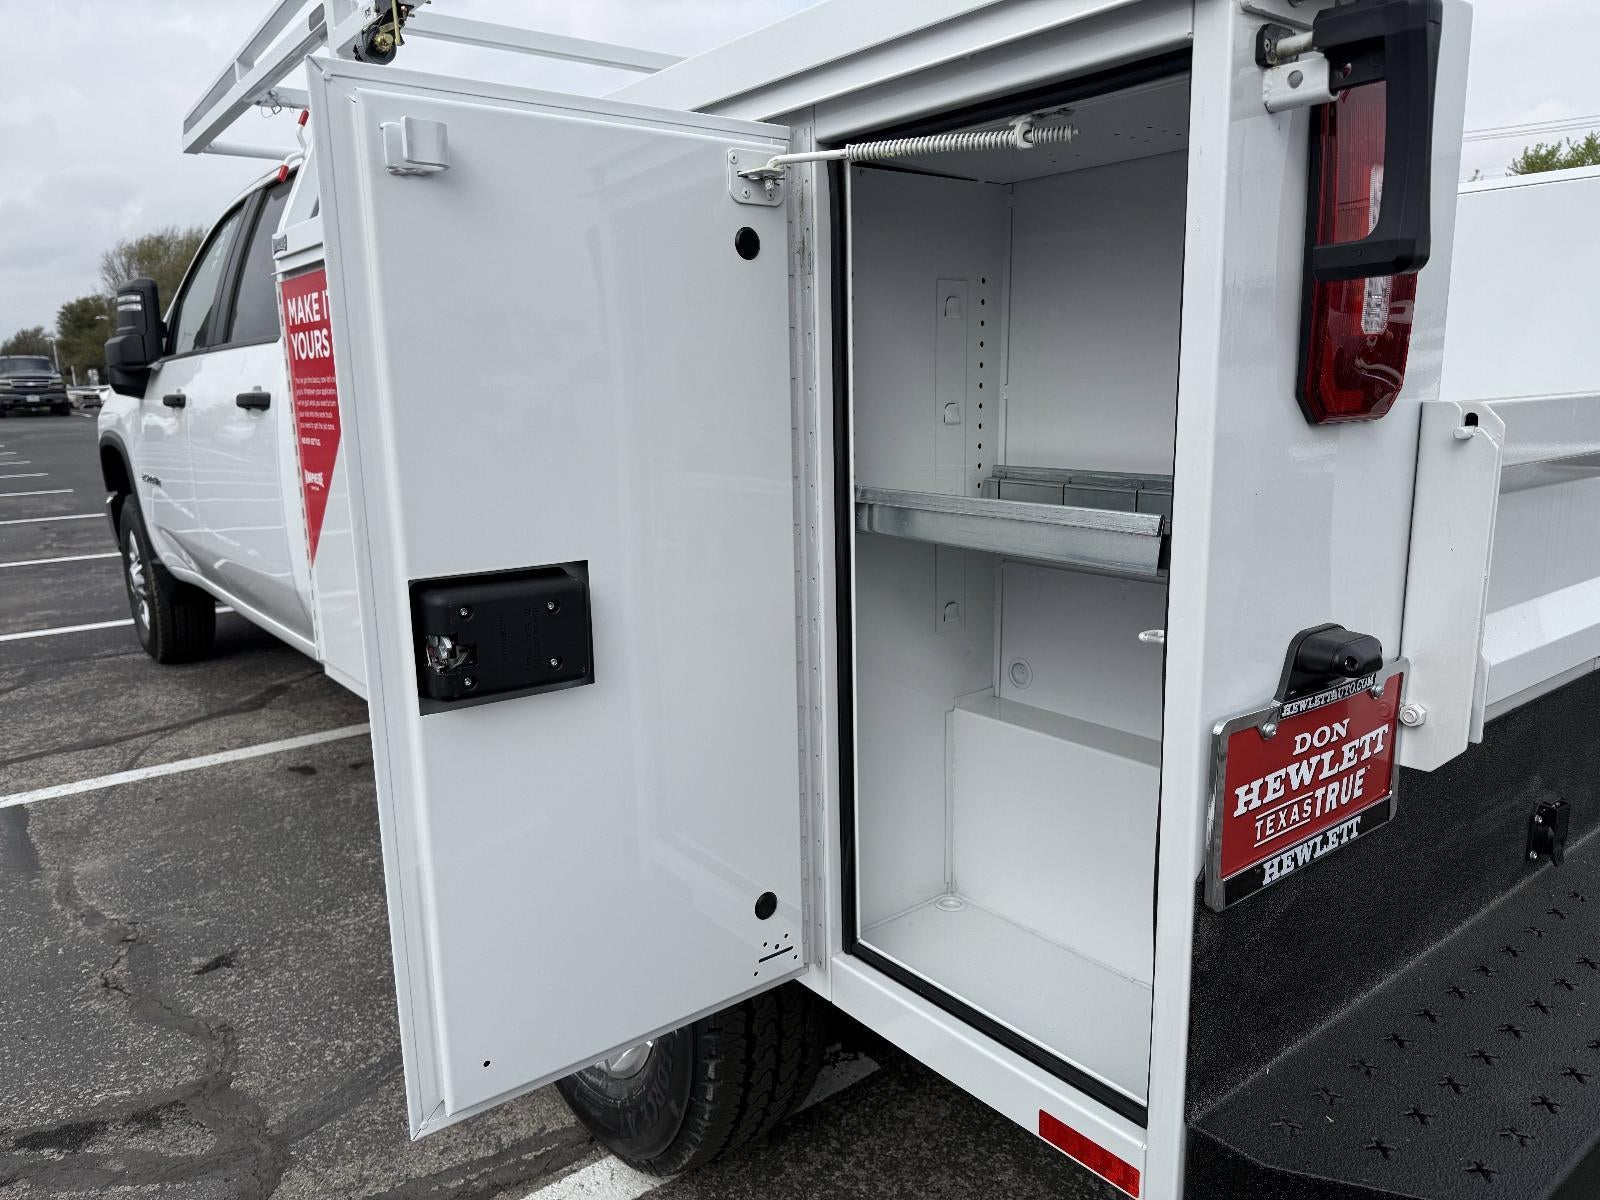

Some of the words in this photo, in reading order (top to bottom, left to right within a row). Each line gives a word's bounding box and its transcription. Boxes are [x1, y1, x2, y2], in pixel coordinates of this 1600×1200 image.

[287, 291, 321, 326] MAKE
[290, 328, 330, 361] YOURS
[1292, 718, 1350, 756] DON
[1233, 723, 1389, 818] HEWLETT
[1262, 815, 1362, 886] HEWLETT
